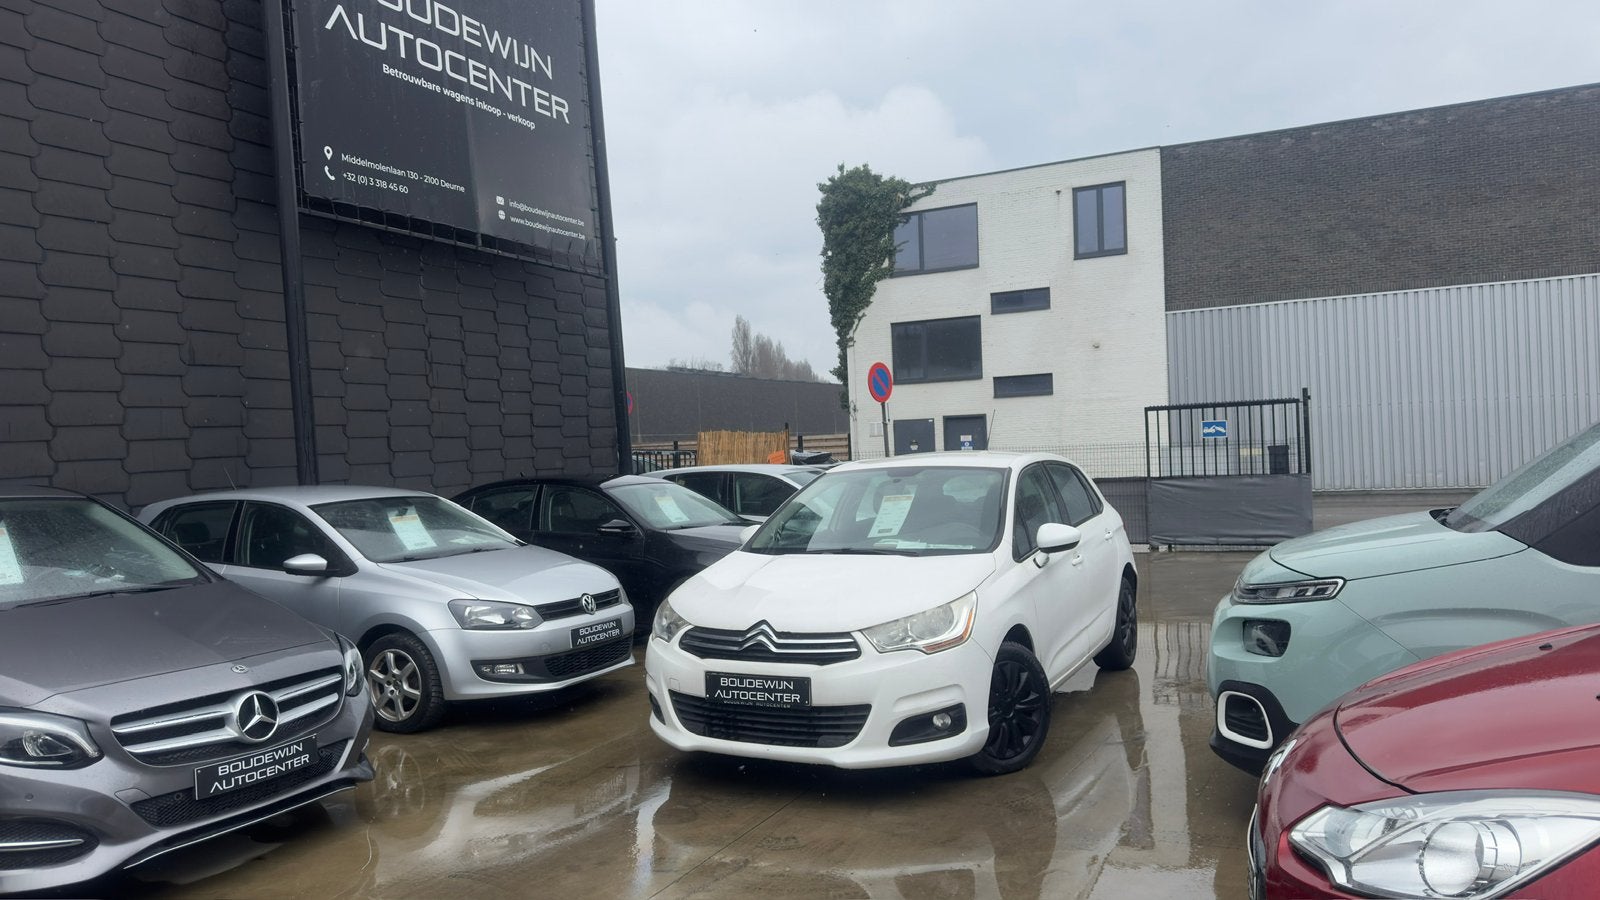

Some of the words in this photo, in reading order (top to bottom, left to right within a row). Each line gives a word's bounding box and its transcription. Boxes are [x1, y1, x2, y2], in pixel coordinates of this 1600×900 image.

[325, 4, 570, 125] AUTOCENTER
[382, 63, 441, 93] Betrouwbare
[442, 87, 475, 106] wagens
[475, 97, 502, 117] inkoop
[507, 112, 536, 131] verkoop
[341, 153, 406, 177] Middelmolenlaan
[406, 170, 419, 180] 130
[423, 175, 440, 186] 2100
[440, 179, 466, 193] Deurne
[342, 172, 356, 182] +32
[357, 174, 368, 186] (0)
[369, 177, 375, 186] 3
[375, 178, 388, 189] 318
[388, 182, 398, 192] 45
[399, 185, 409, 194] 60
[508, 199, 585, 227] info@boudewijnautocenter.be
[510, 216, 586, 240] www.boudewijnautocenter.be
[576, 628, 620, 646] AUTOCENTER
[579, 620, 616, 636] BOUDEWIJN
[714, 689, 801, 703] AUTOCENTER
[720, 677, 794, 690] BOUDEWIJN
[218, 742, 303, 776] BOUDEWIJN
[210, 753, 310, 794] AUTOCENTER
